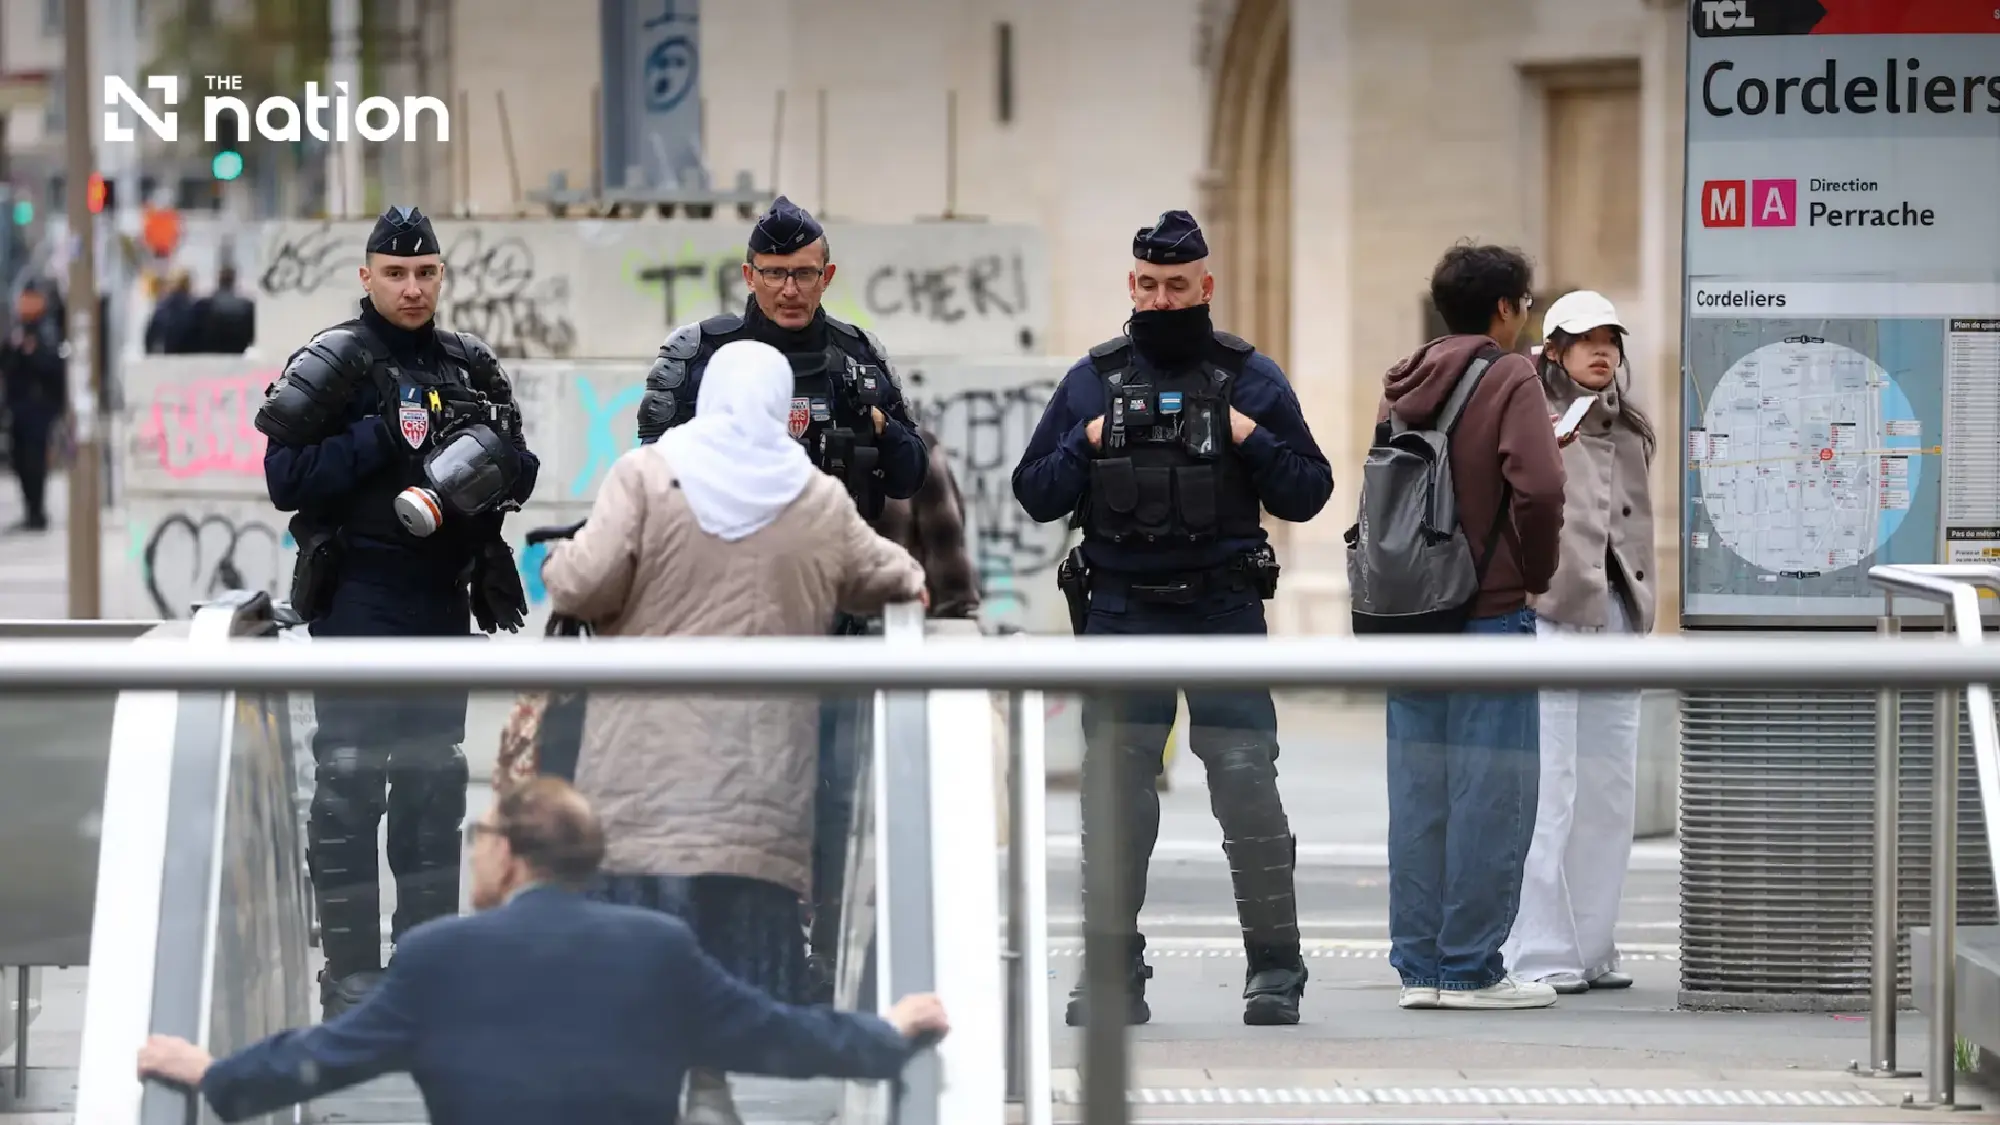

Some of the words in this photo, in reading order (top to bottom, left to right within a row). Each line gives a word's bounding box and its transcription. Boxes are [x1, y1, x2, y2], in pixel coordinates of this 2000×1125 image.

[1702, 0, 1755, 30] TCL
[1810, 179, 1878, 192] Direction
[1710, 188, 1736, 221] M
[1761, 187, 1787, 220] A
[1810, 202, 1935, 227] Perrache
[1696, 290, 1787, 308] Cordeliers
[1954, 321, 1970, 329] Plan
[404, 421, 425, 431] CRS
[1951, 530, 1965, 538] Pas
